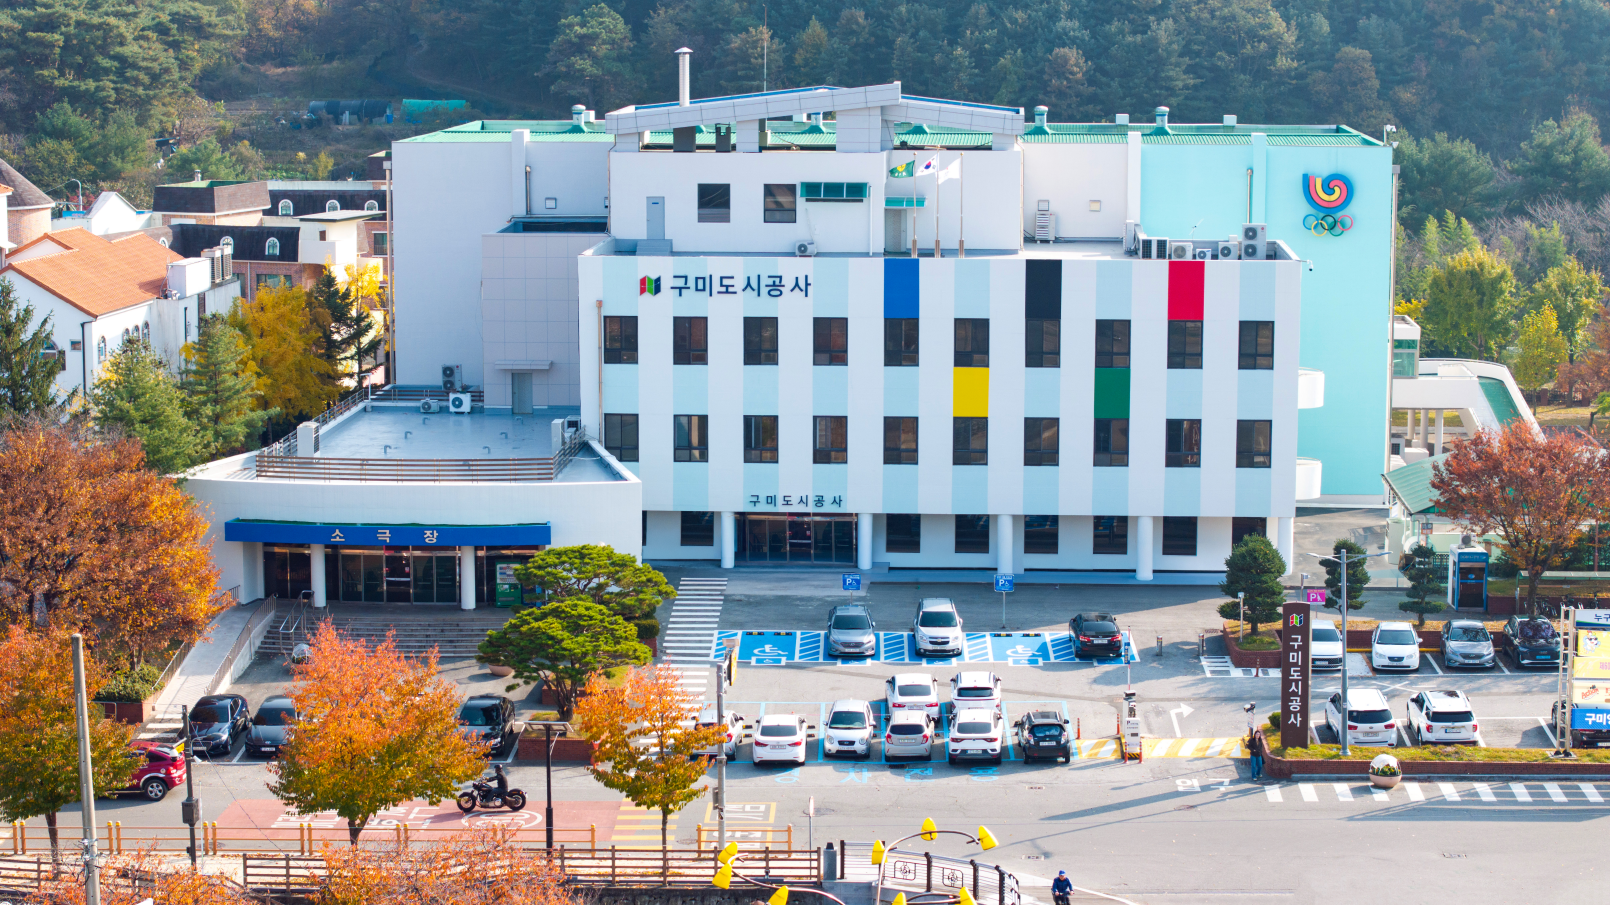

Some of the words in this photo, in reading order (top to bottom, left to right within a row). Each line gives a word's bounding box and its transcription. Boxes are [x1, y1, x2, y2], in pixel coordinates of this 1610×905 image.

[670, 274, 812, 298] 구미도시공사
[749, 494, 843, 508] 구미도시공사
[330, 529, 438, 544] 소극장
[846, 578, 852, 586] P
[998, 579, 1005, 587] P
[1310, 593, 1316, 602] P
[1288, 635, 1303, 728] 구미도시공사
[1175, 778, 1233, 791] 입구
